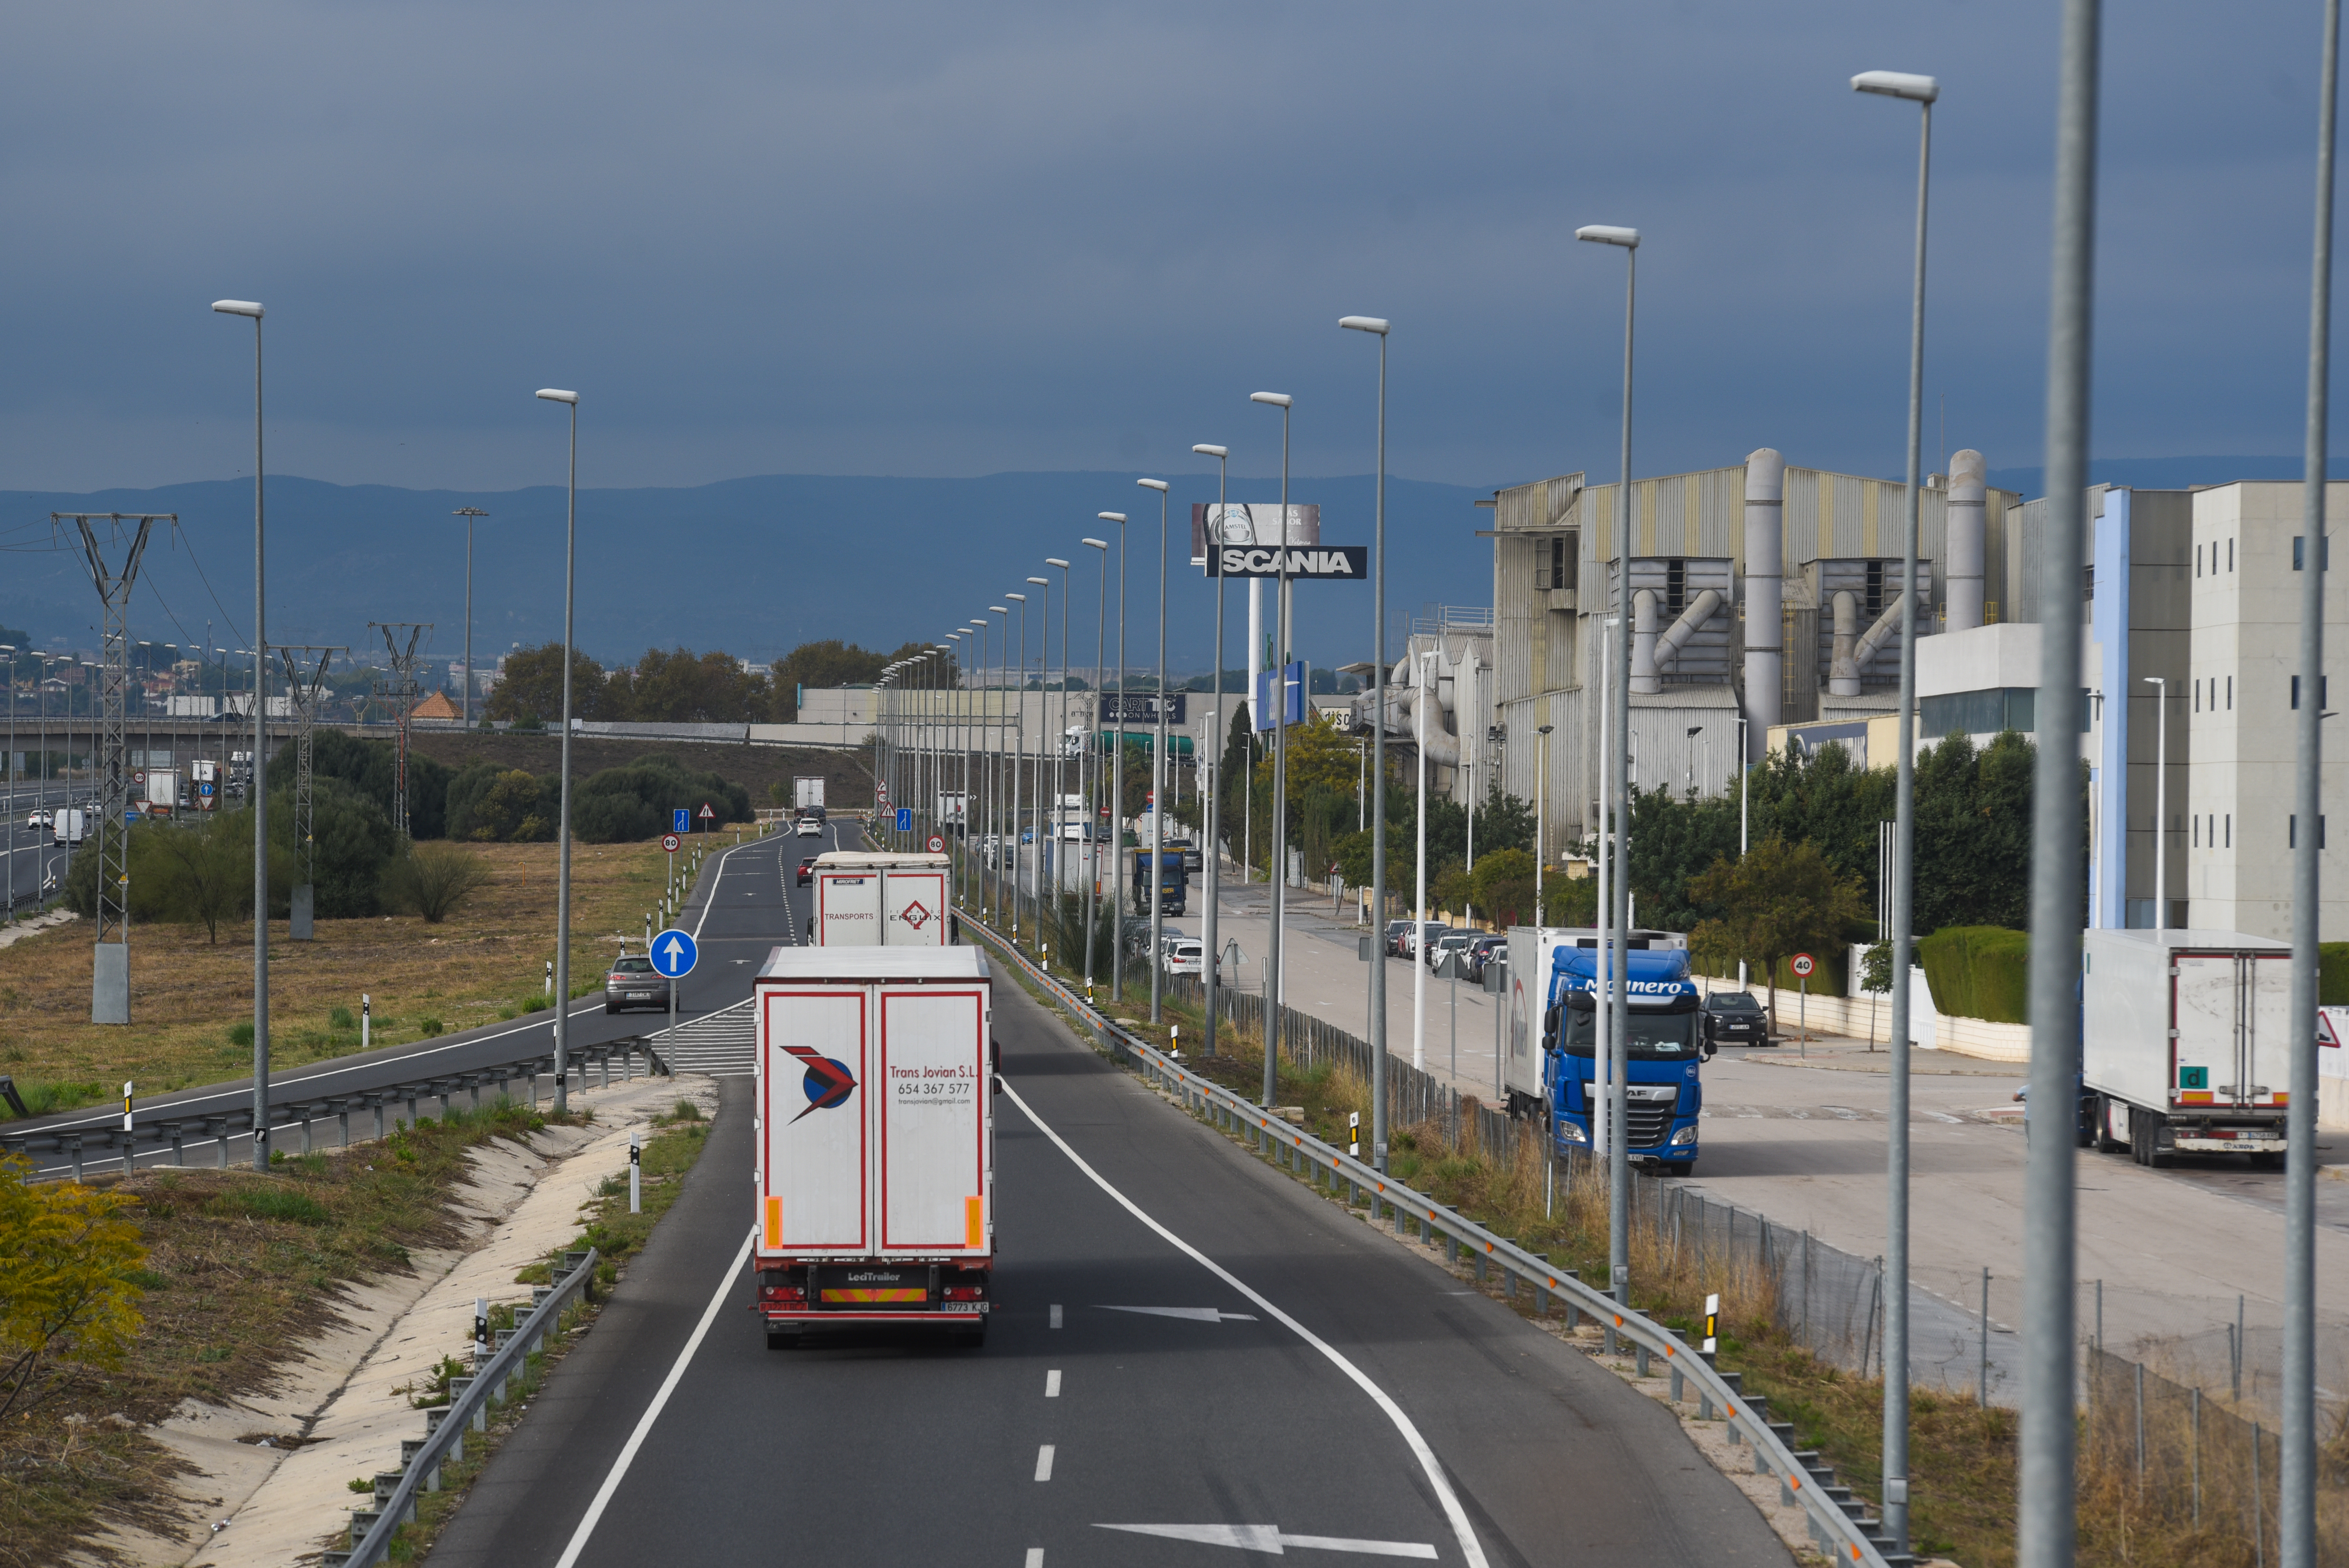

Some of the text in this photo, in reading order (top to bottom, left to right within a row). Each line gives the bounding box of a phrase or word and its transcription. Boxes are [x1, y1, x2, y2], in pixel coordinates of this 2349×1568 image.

[1223, 549, 1353, 573] SCANIA
[1796, 961, 1810, 970] 40
[890, 1065, 978, 1078] Trans Jovian S.L.
[2188, 1069, 2200, 1086] d
[898, 1083, 970, 1094] 654 367 577
[898, 1097, 970, 1106] transjovian@gmail.com
[848, 1272, 900, 1281] LeciTrailer
[947, 1303, 988, 1311] 6773 KJG
